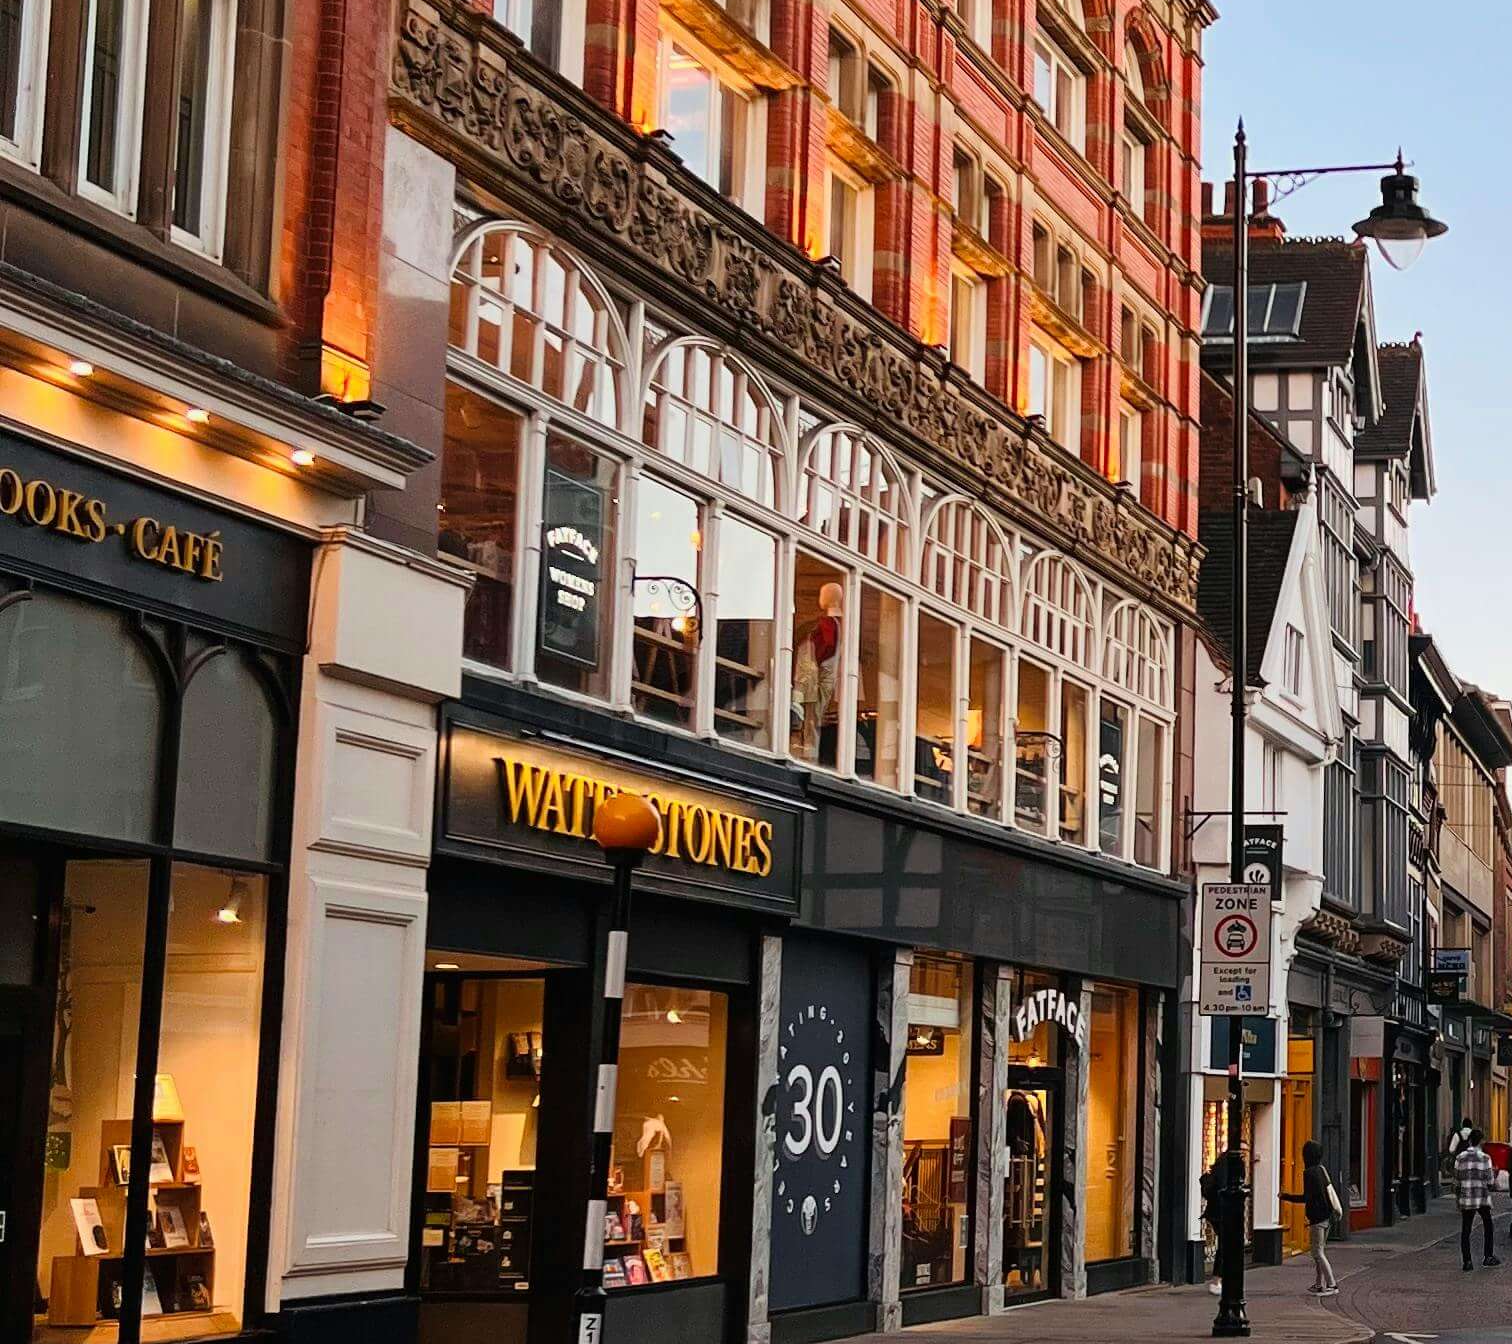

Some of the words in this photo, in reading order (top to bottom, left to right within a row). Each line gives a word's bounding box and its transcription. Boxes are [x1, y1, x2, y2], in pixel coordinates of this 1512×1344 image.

[134, 517, 224, 582] CAFÉ
[498, 756, 773, 878] WATESTONES
[1243, 838, 1277, 849] ATFACE
[1208, 886, 1266, 895] PEDESTRIAN
[1215, 898, 1259, 910] ZONE
[1213, 966, 1243, 976] Except
[1244, 966, 1257, 975] for
[1016, 989, 1086, 1051] FATFACE
[784, 1064, 844, 1156] 30
